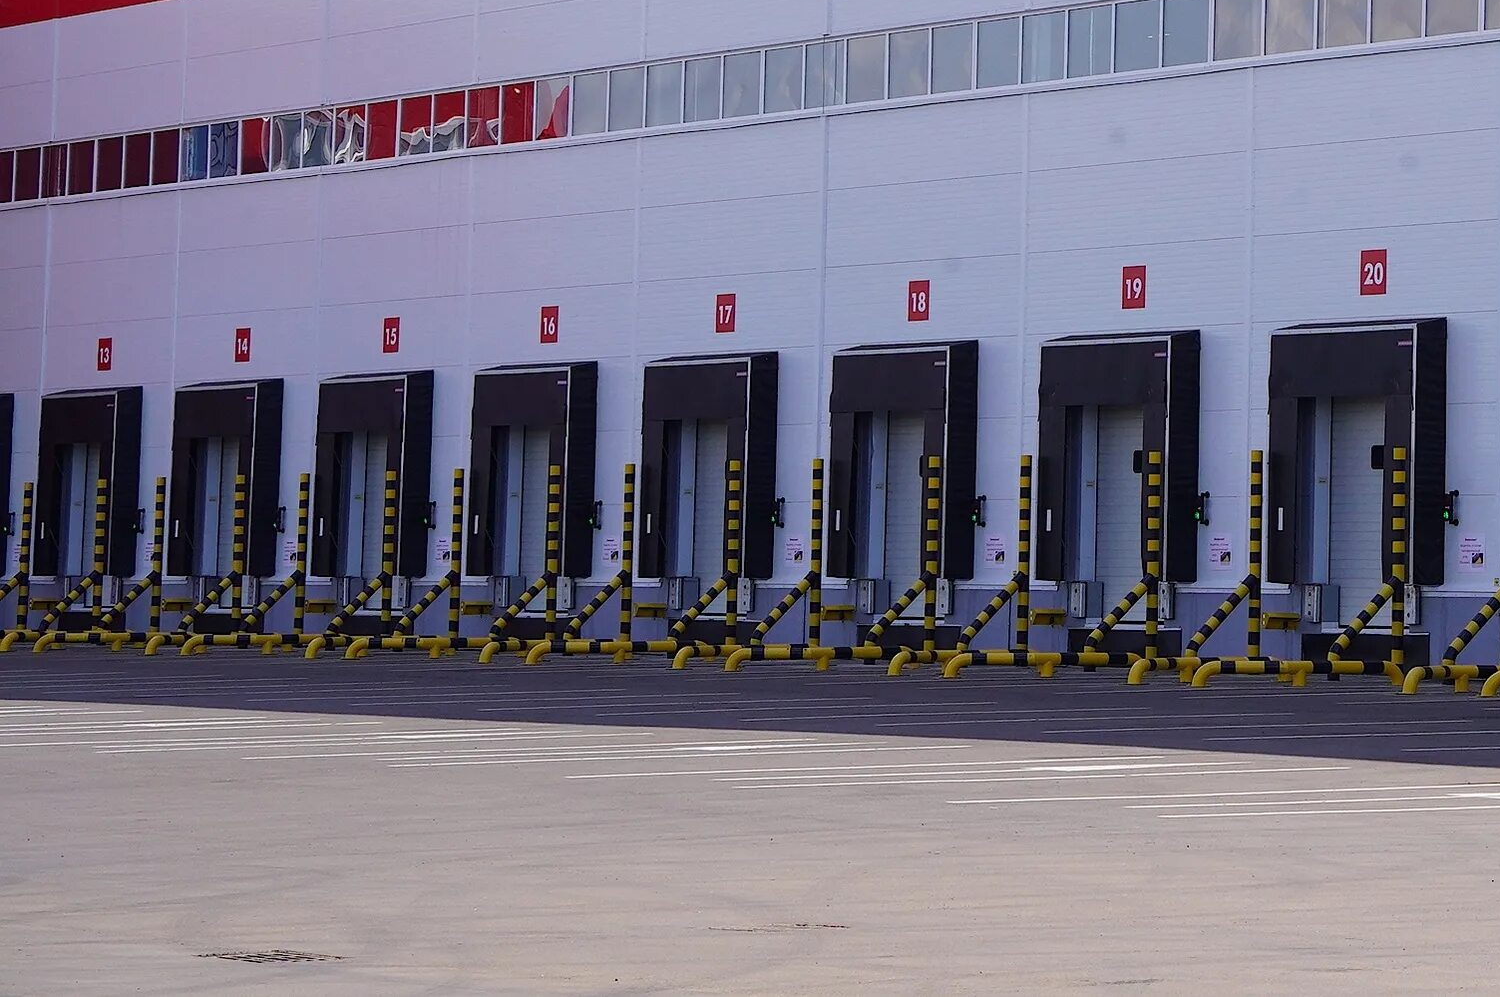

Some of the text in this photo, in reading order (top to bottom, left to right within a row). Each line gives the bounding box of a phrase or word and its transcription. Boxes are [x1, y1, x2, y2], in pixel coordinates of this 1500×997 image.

[1364, 263, 1384, 285] 20
[1126, 278, 1142, 299] 19
[912, 292, 926, 312] 18
[719, 305, 733, 324] 17
[544, 317, 555, 335] 16
[386, 328, 397, 345] 15
[237, 338, 248, 354] 14
[99, 348, 110, 364] 13
